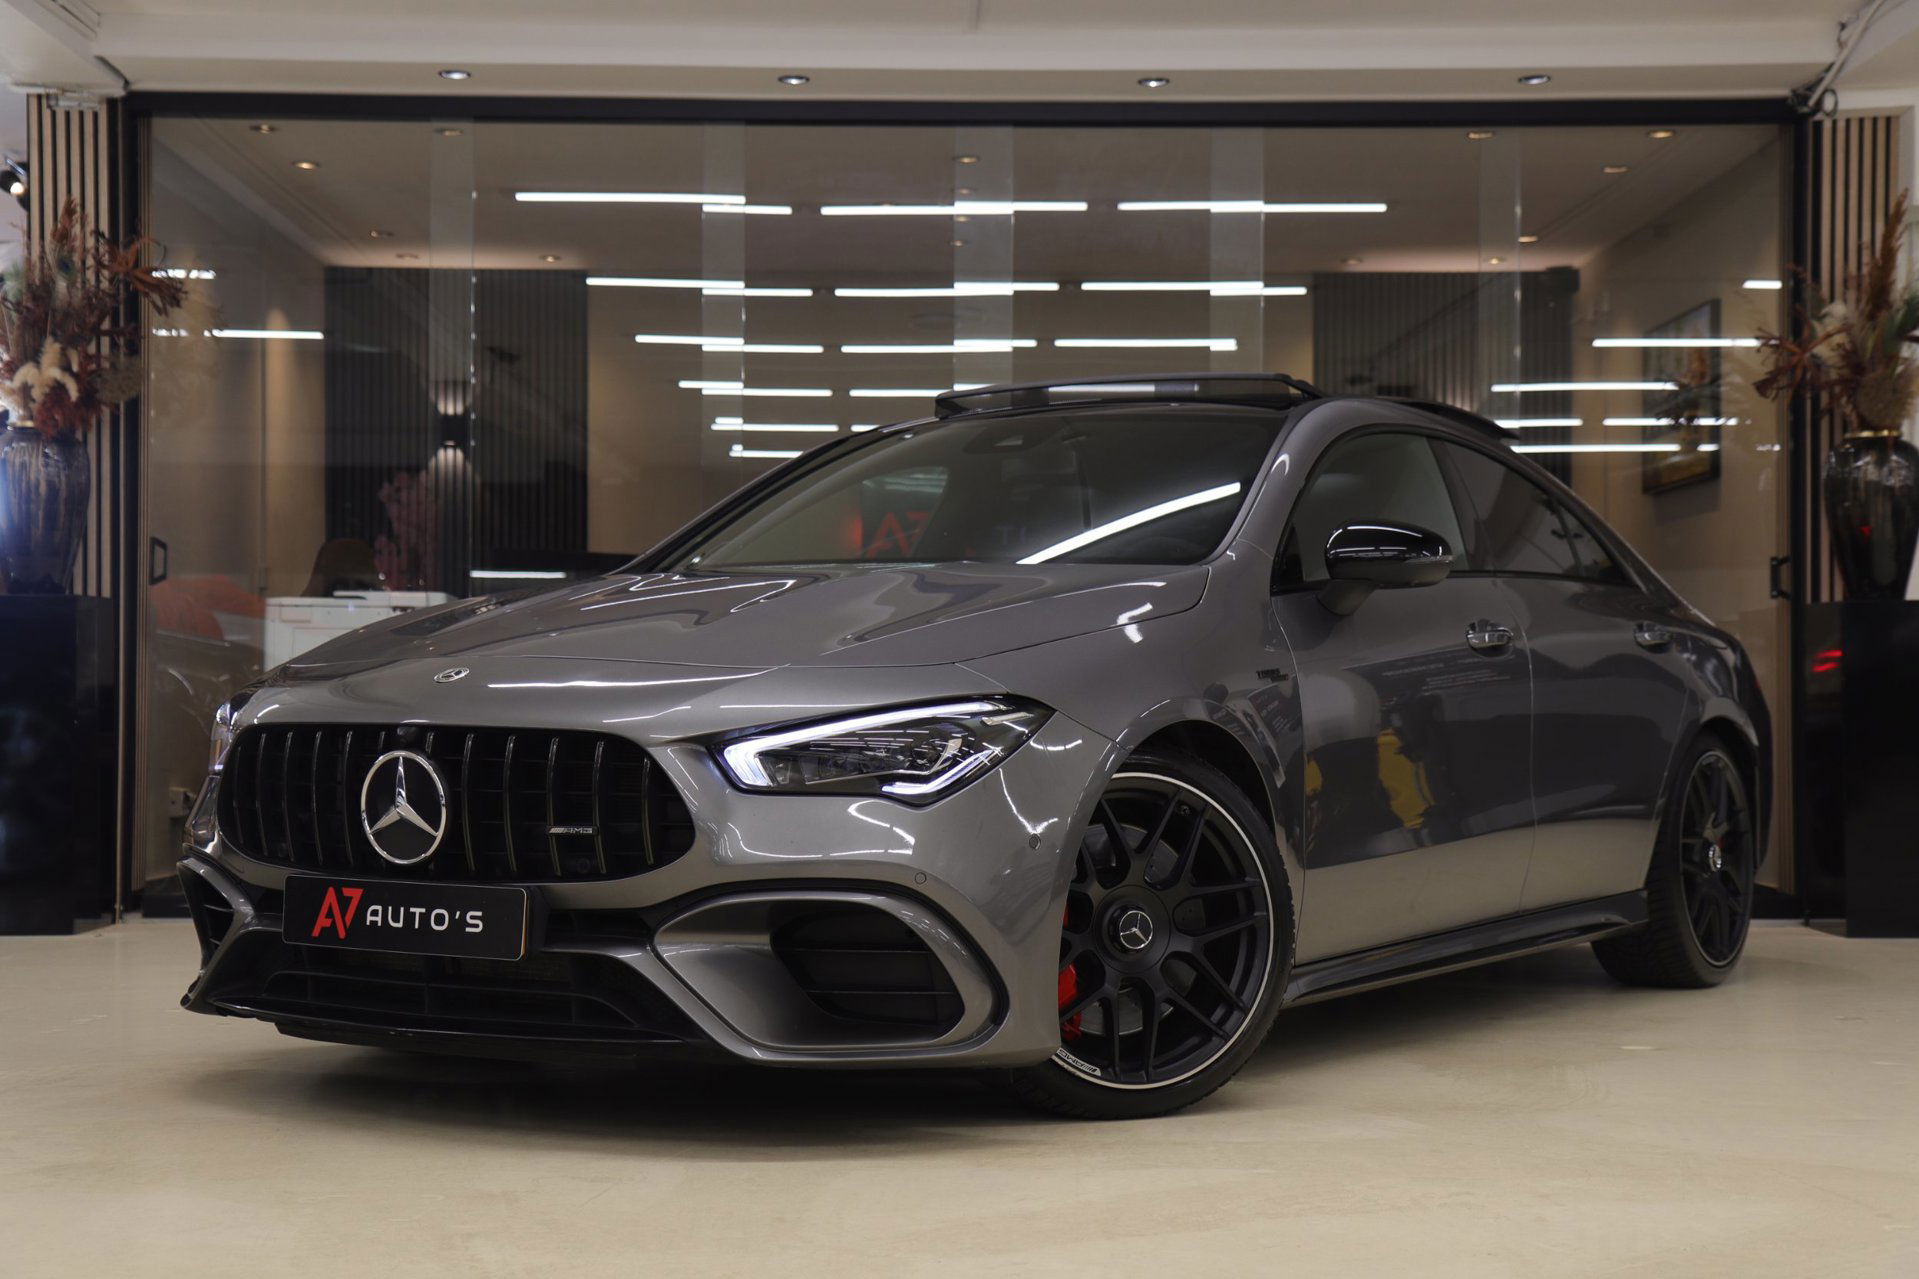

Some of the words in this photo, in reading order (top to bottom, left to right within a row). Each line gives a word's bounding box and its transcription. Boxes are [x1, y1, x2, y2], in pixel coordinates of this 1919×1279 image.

[867, 511, 930, 558] A7
[311, 886, 364, 940] A7
[366, 905, 483, 933] AUTO'S
